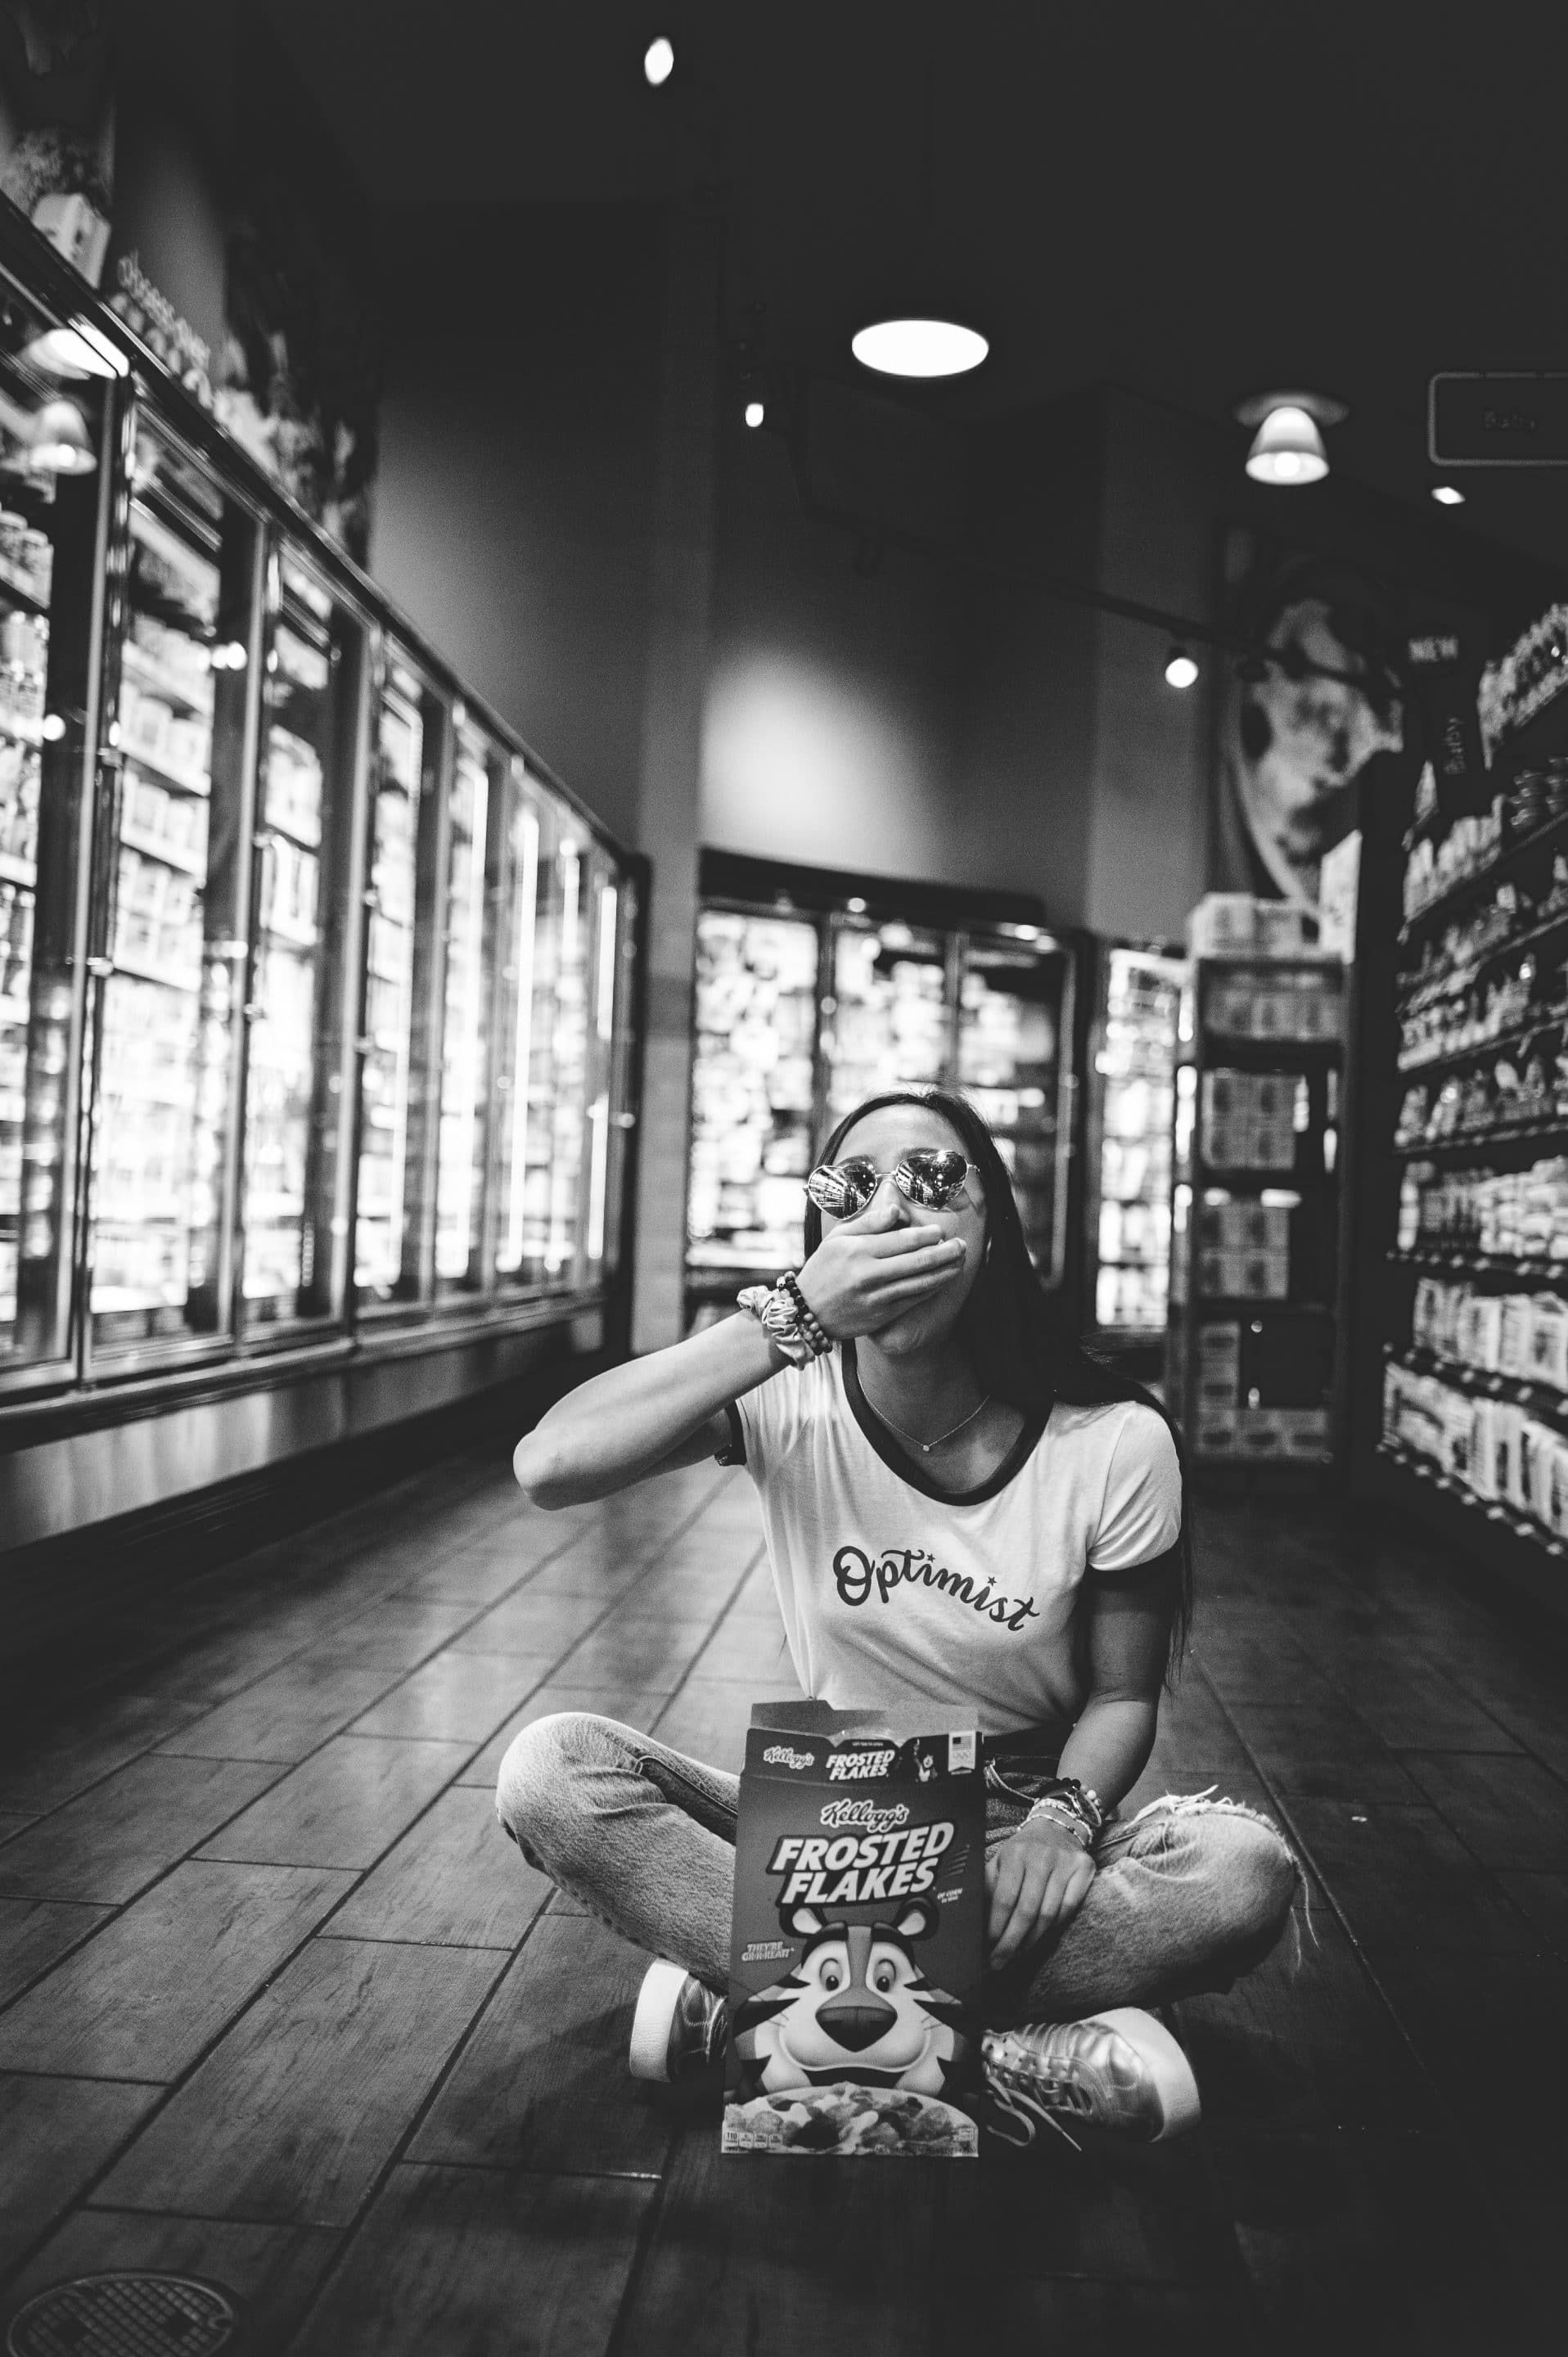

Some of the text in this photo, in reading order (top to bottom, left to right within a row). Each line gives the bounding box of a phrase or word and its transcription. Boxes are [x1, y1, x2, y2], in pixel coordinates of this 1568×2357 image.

[832, 1545, 1040, 1631] Optimist
[826, 1750, 895, 1769] FROSTED
[829, 1763, 888, 1781] FLAKES
[821, 1798, 909, 1833] Kellogg's
[772, 1822, 954, 1871] FROSTED
[782, 1858, 939, 1904] FLAKES
